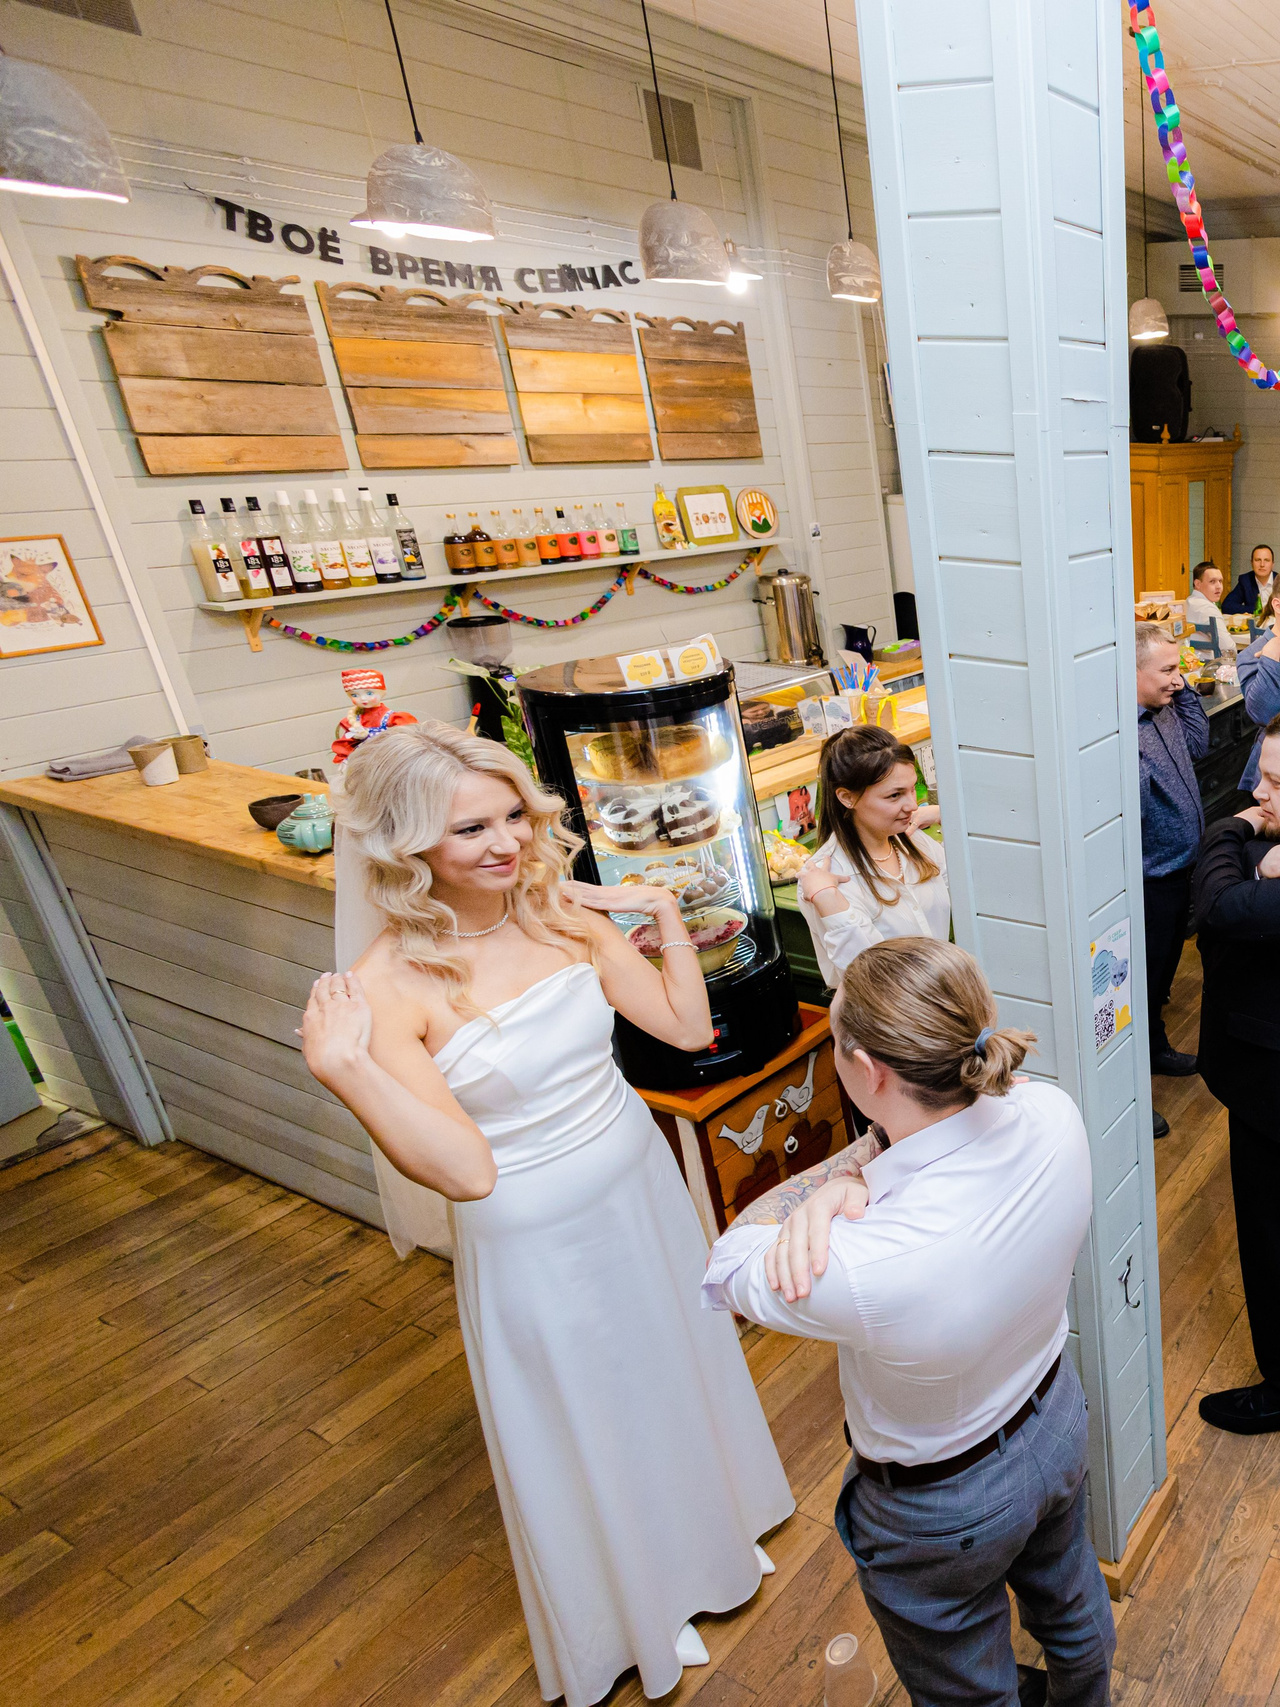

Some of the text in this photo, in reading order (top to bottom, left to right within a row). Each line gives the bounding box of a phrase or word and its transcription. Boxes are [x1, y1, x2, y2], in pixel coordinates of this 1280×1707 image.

[213, 196, 641, 293] ТВОЁ ВРЕМЯ СЕЙЧАС
